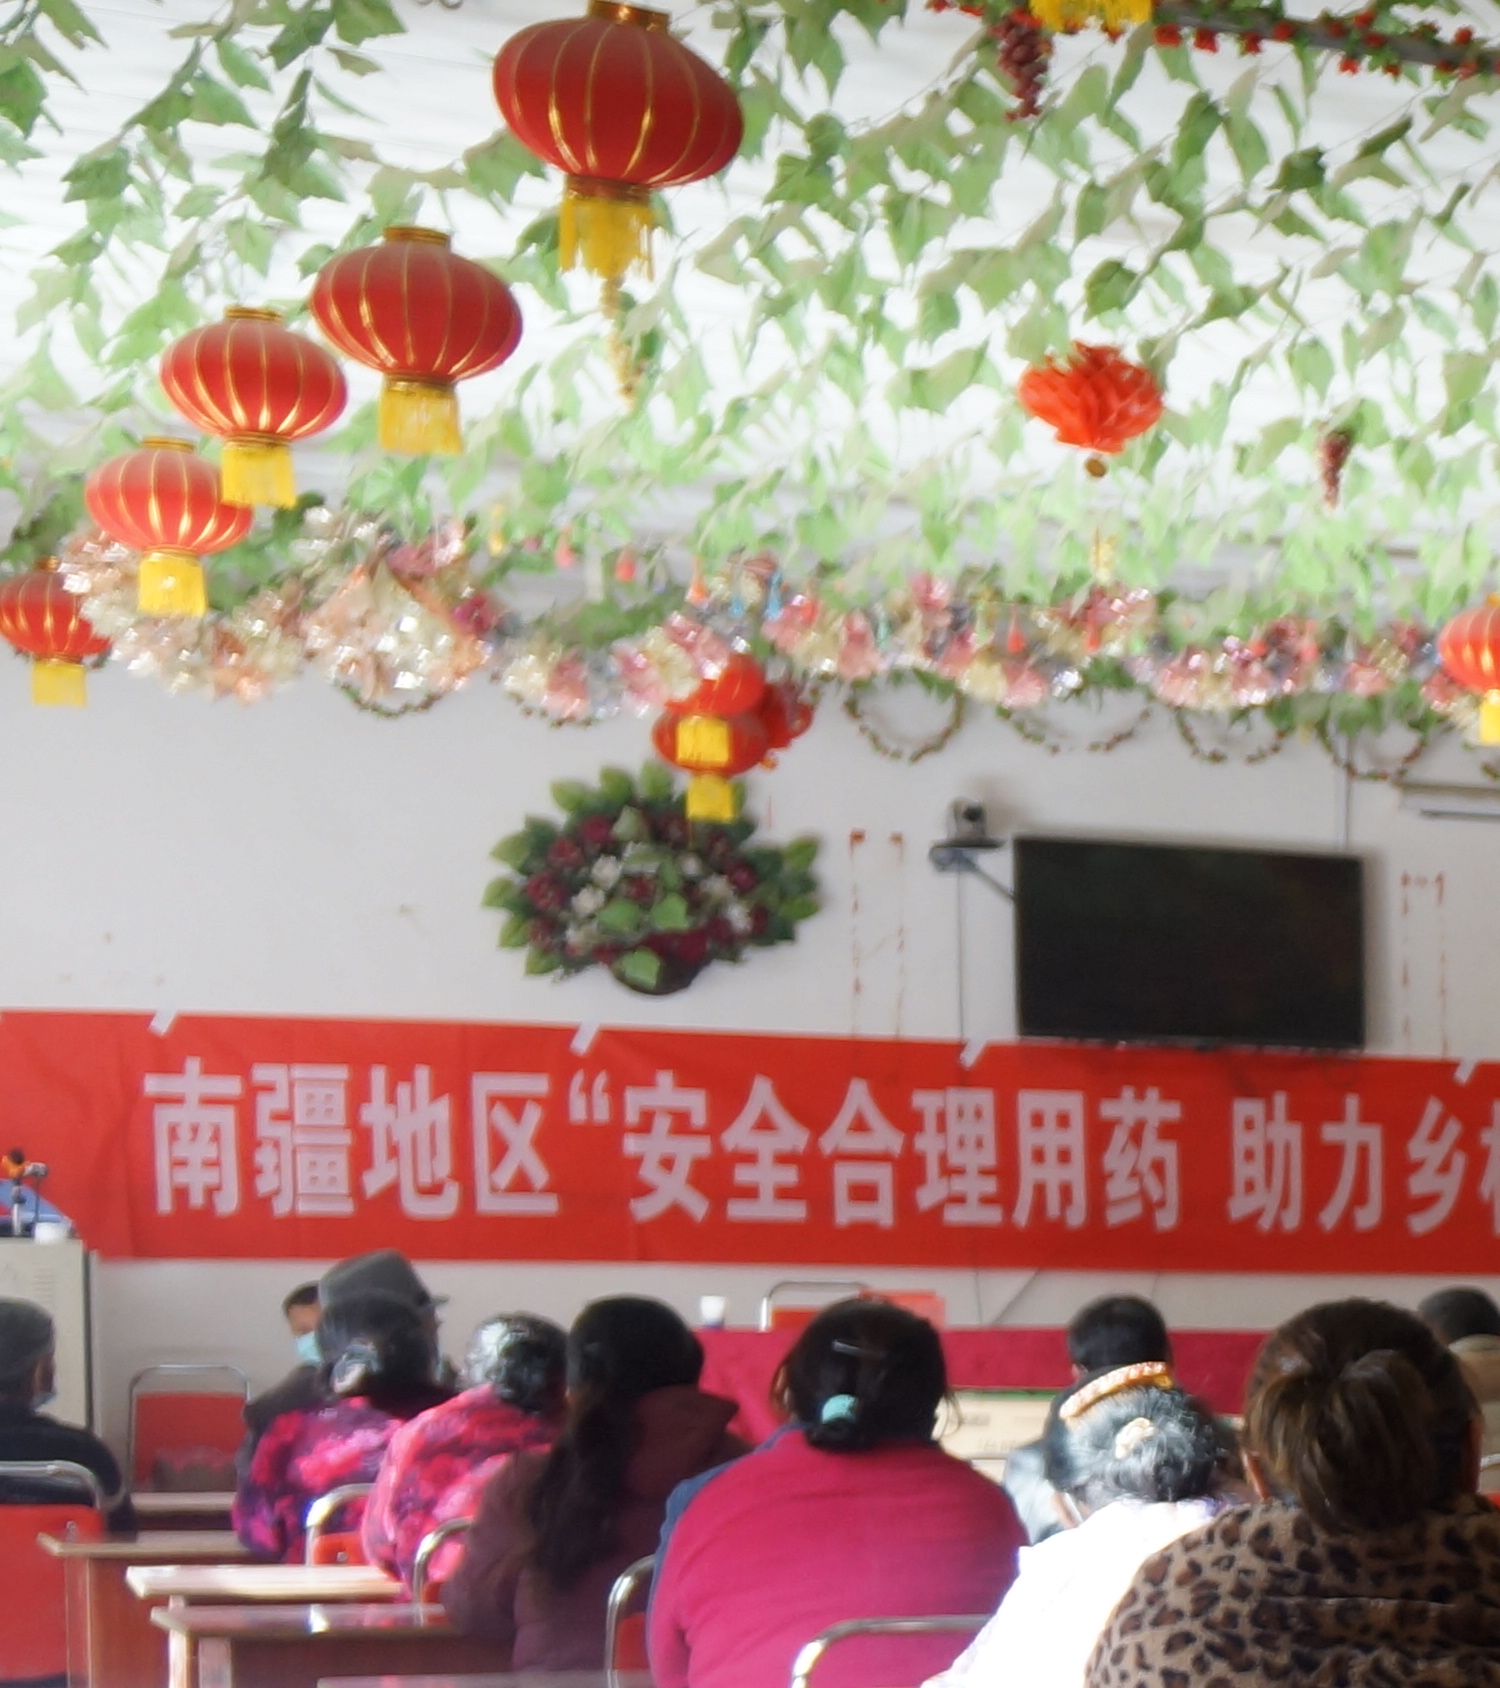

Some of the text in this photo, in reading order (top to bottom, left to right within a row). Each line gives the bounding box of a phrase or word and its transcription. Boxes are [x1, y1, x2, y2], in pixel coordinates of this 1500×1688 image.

[142, 1056, 1182, 1230] 南疆地区“安全合理用药
